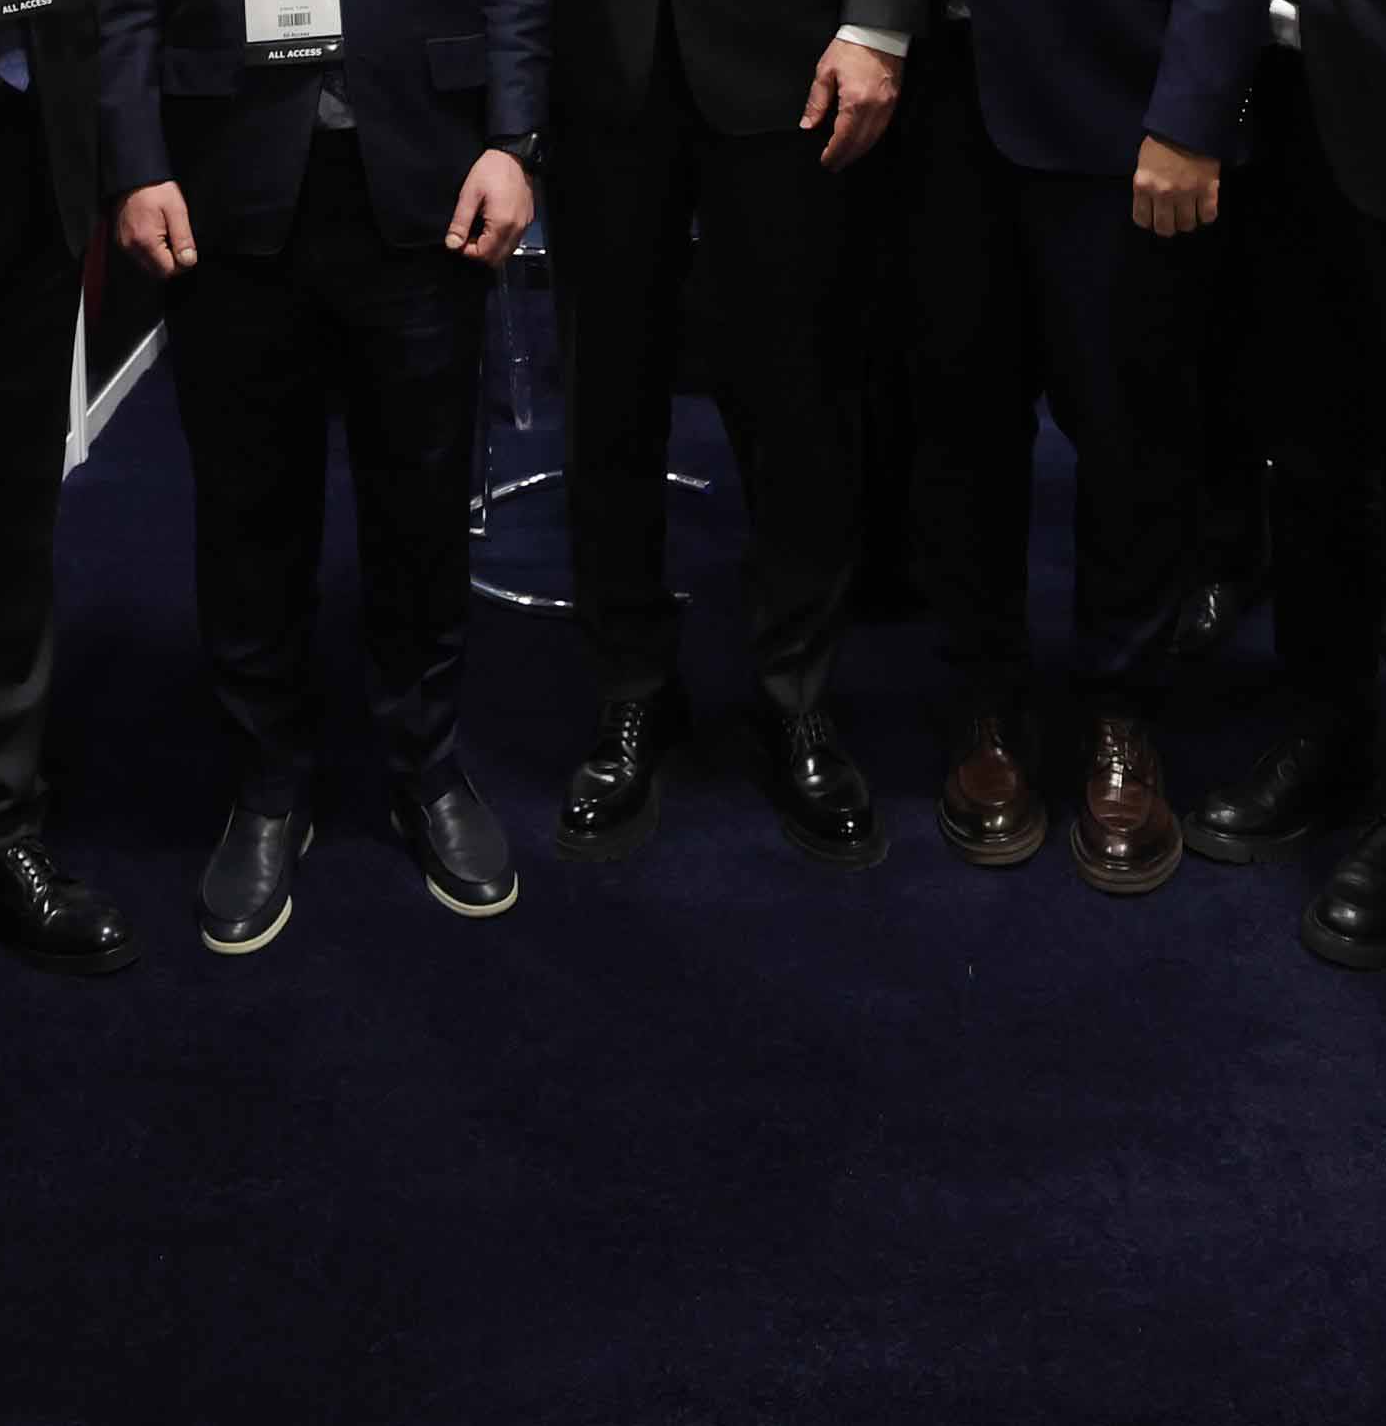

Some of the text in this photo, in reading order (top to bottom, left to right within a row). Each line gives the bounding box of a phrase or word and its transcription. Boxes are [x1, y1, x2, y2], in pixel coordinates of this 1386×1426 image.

[2, 3, 19, 15] ALL
[268, 47, 323, 60] ALL ACCESS
